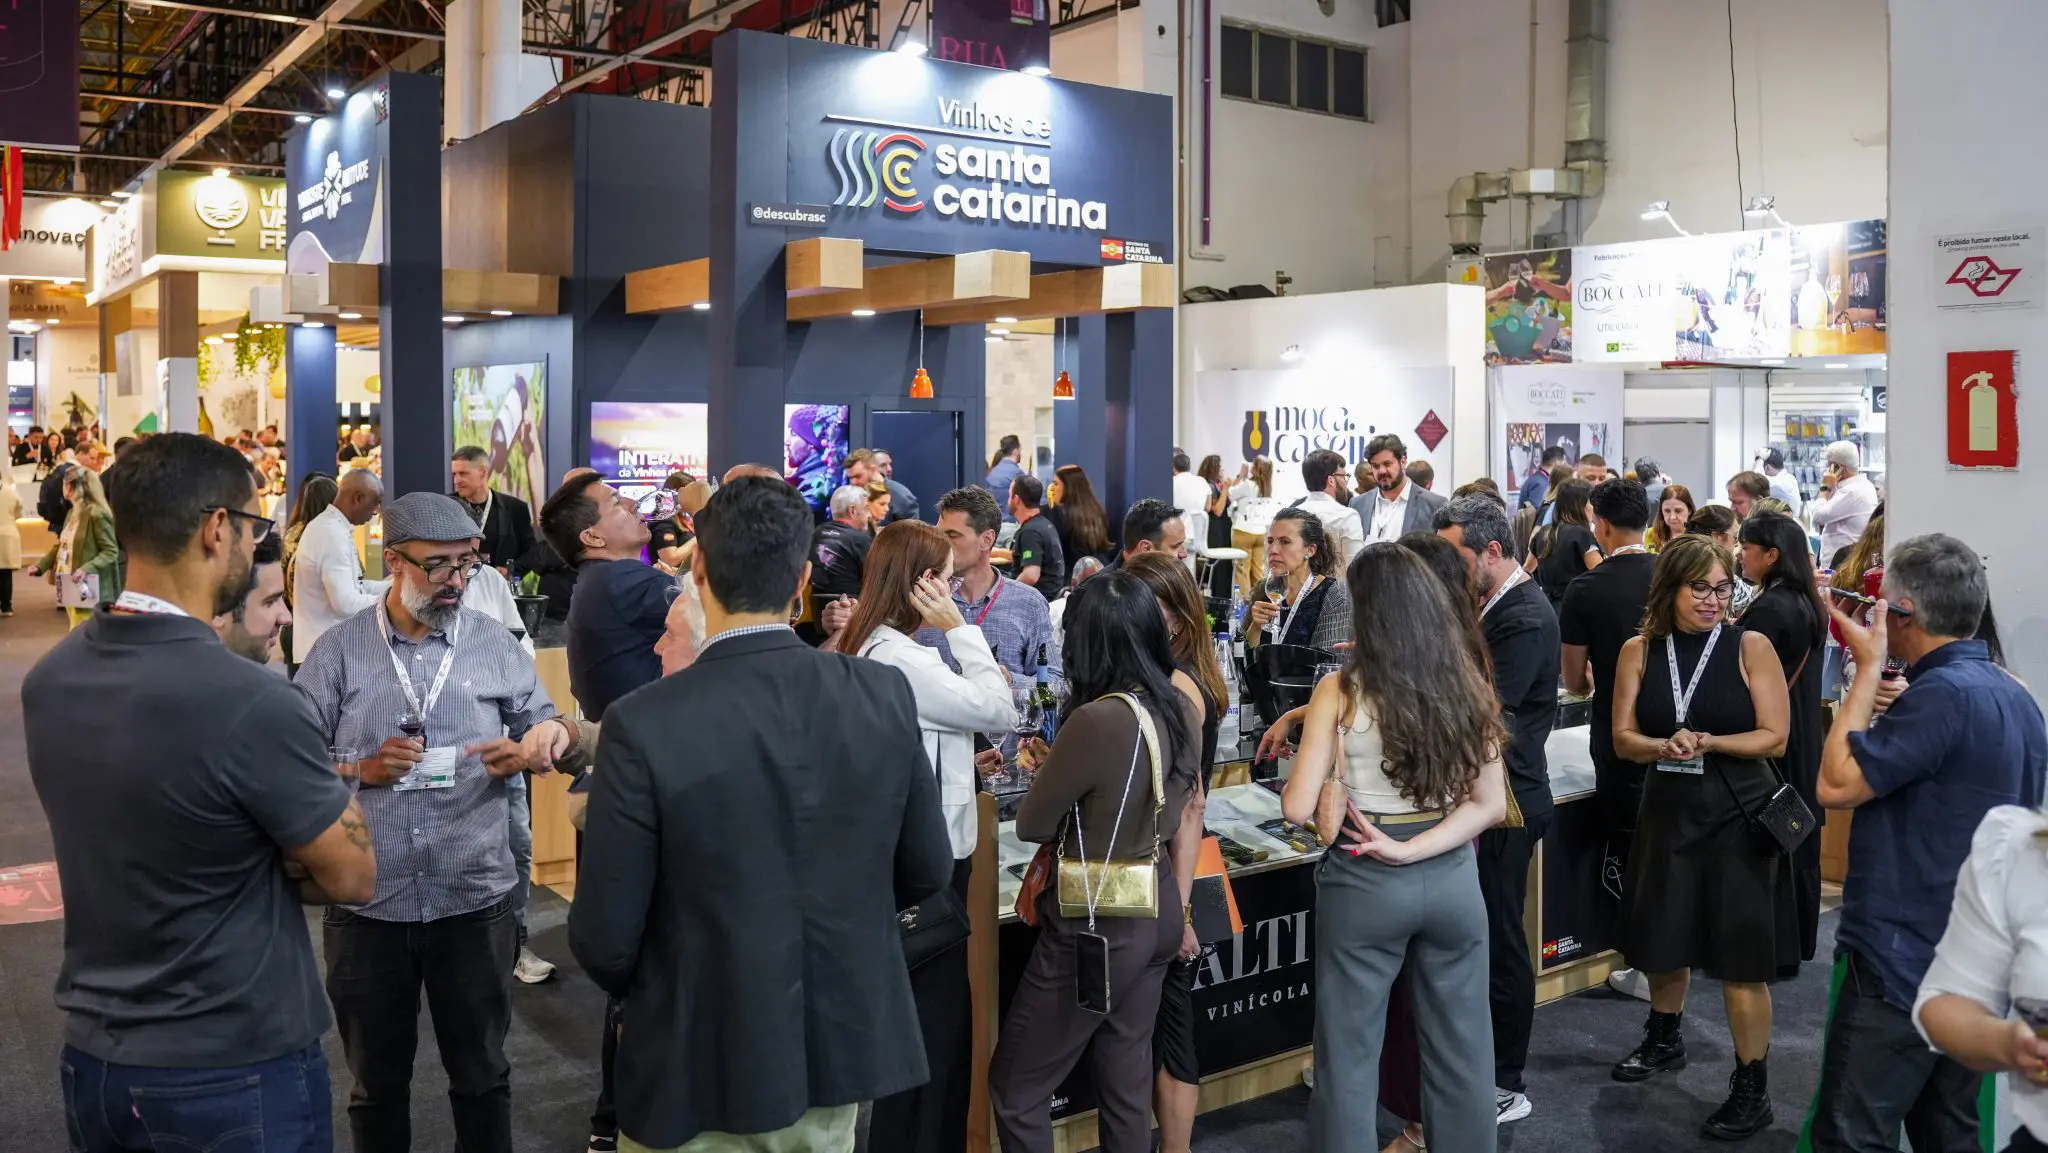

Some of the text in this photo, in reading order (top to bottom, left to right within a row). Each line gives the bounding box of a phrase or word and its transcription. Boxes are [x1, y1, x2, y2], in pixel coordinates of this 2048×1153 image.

[938, 96, 1051, 138] Vinhos de
[935, 142, 1050, 185] santa
[753, 207, 826, 222] @descubrasc
[933, 182, 1107, 230] catarina
[18, 226, 86, 251] inovaç
[1943, 238, 1970, 248] proibido
[1125, 245, 1150, 255] SANTA
[1125, 254, 1163, 264] CATARINA
[618, 468, 631, 477] da
[1207, 982, 1309, 1021] VINÍCOLA
